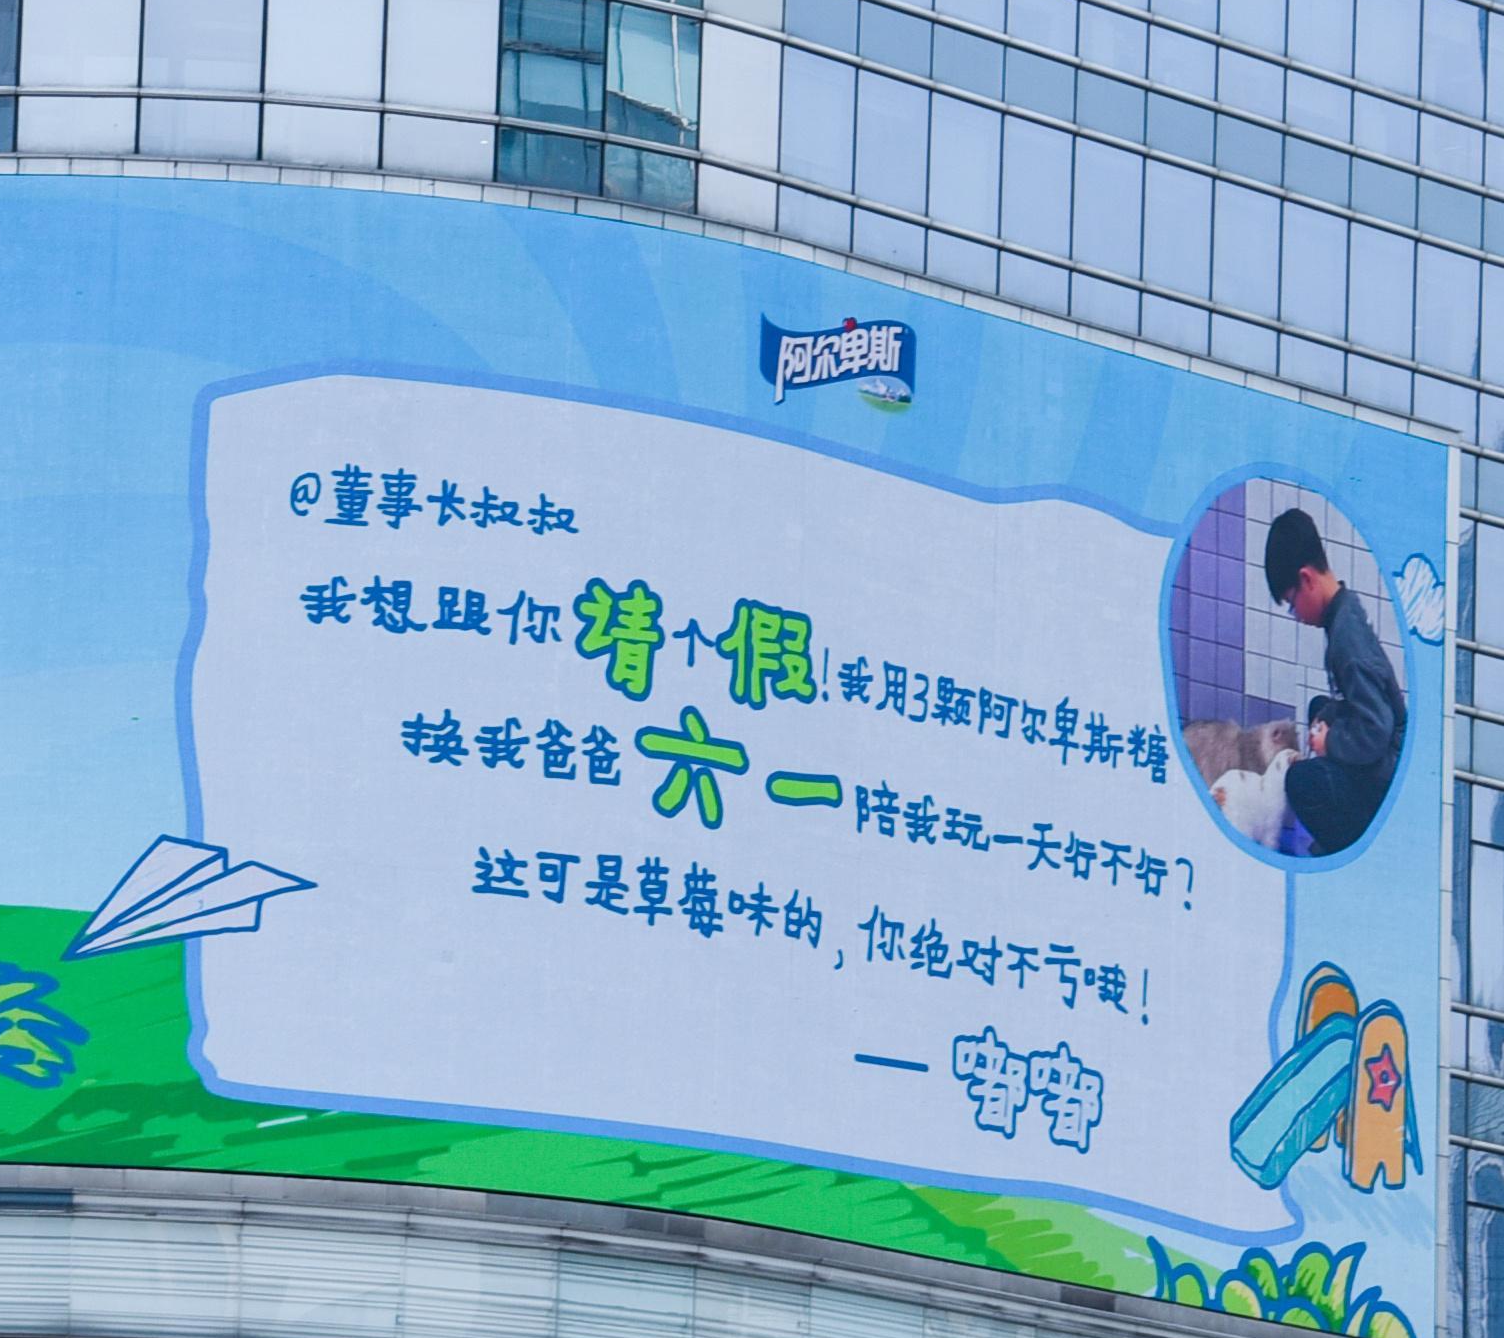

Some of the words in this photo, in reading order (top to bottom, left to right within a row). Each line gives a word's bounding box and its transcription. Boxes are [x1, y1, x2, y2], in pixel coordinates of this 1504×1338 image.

[773, 325, 903, 405] 阿尔卑斯
[290, 464, 579, 536] @董事长叔叔
